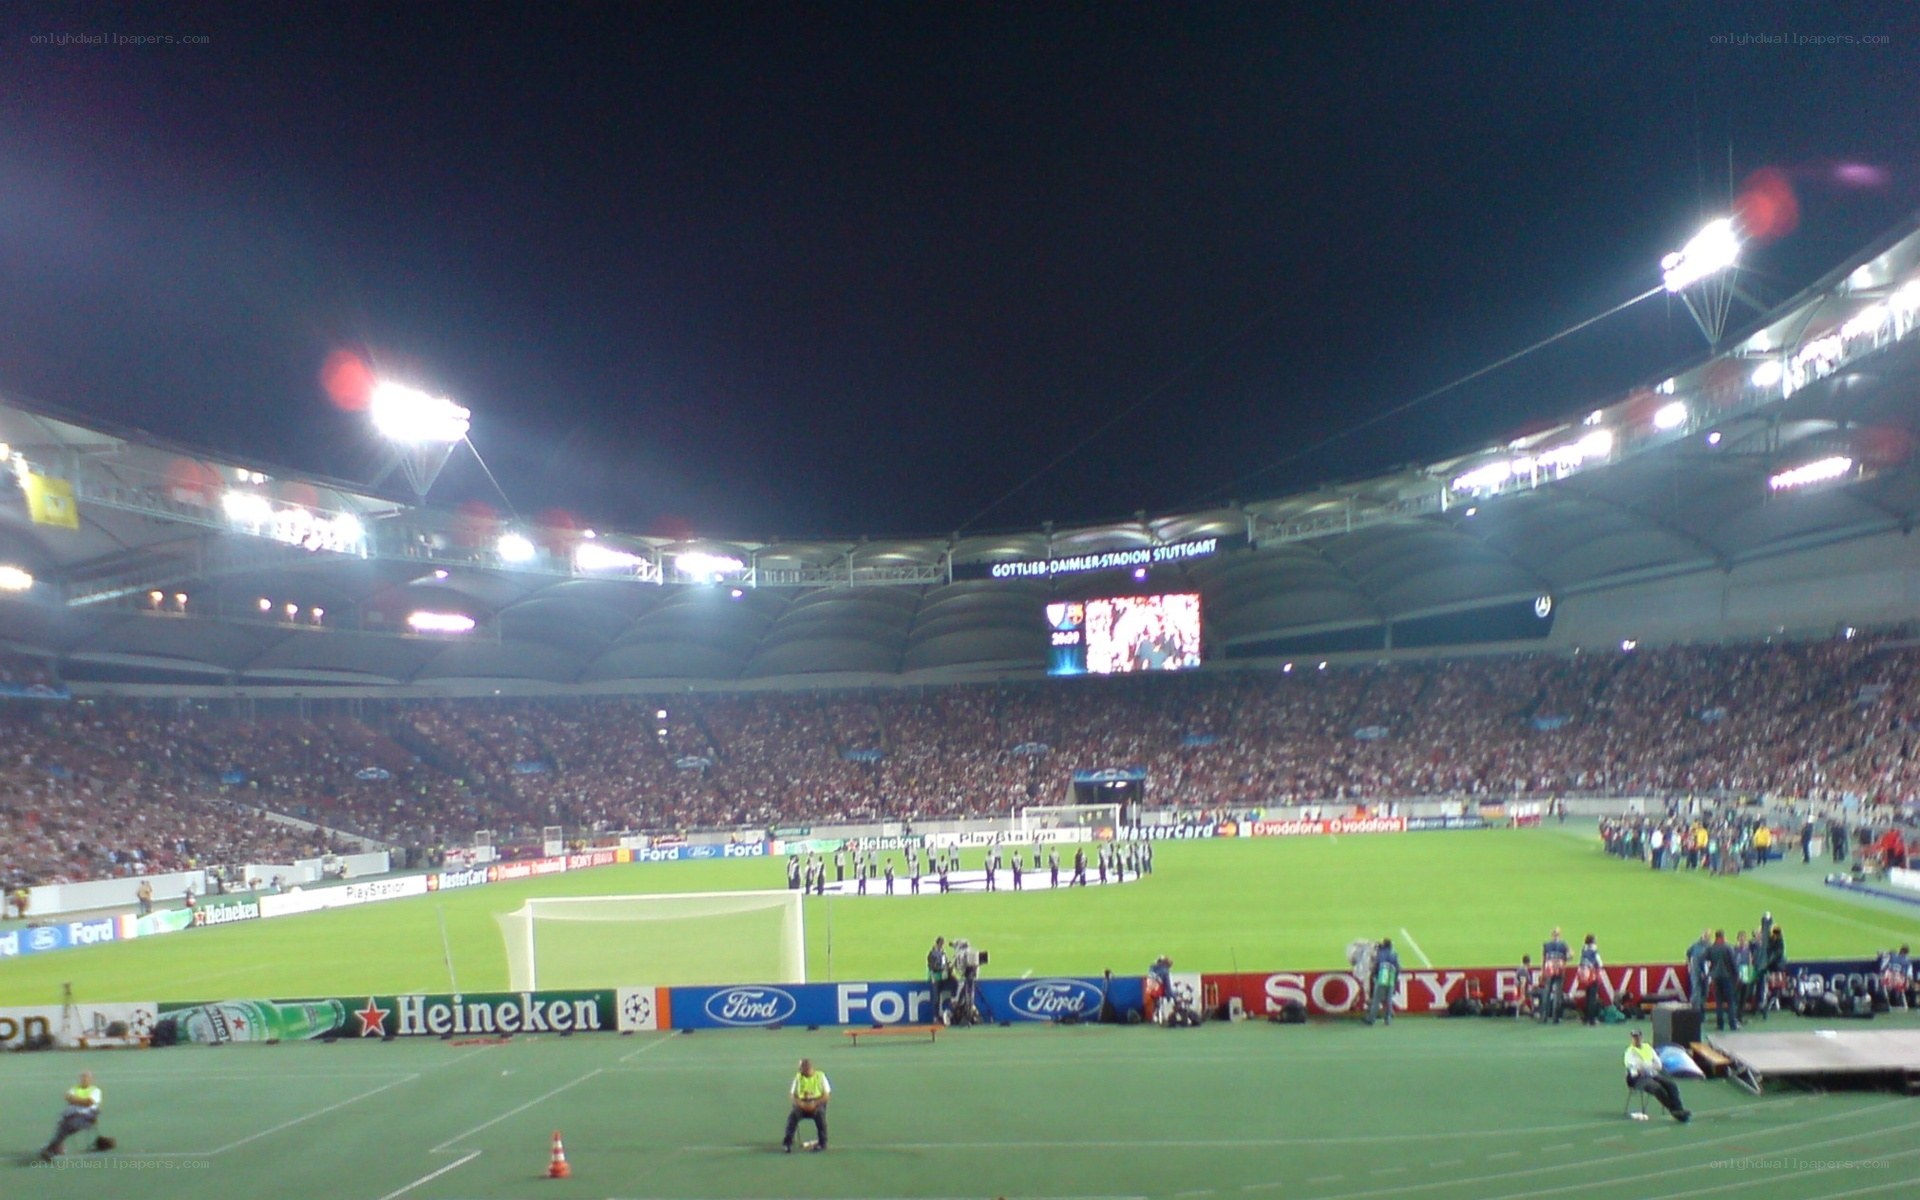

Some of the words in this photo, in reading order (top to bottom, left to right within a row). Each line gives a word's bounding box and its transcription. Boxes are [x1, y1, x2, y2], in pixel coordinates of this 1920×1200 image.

[1153, 538, 1217, 562] STUTTGART
[1118, 822, 1213, 839] MasterCard
[1266, 819, 1323, 834] vodafone
[1343, 817, 1401, 832] vodafone
[724, 841, 763, 857] Ford
[859, 836, 920, 850] Heineken
[640, 847, 679, 862] Ford
[439, 867, 488, 890] MasterCard
[206, 902, 258, 924] Heineken
[70, 919, 114, 945] Ford
[724, 991, 777, 1018] Ford
[1028, 984, 1084, 1013] Ford
[398, 993, 600, 1034] Heineken
